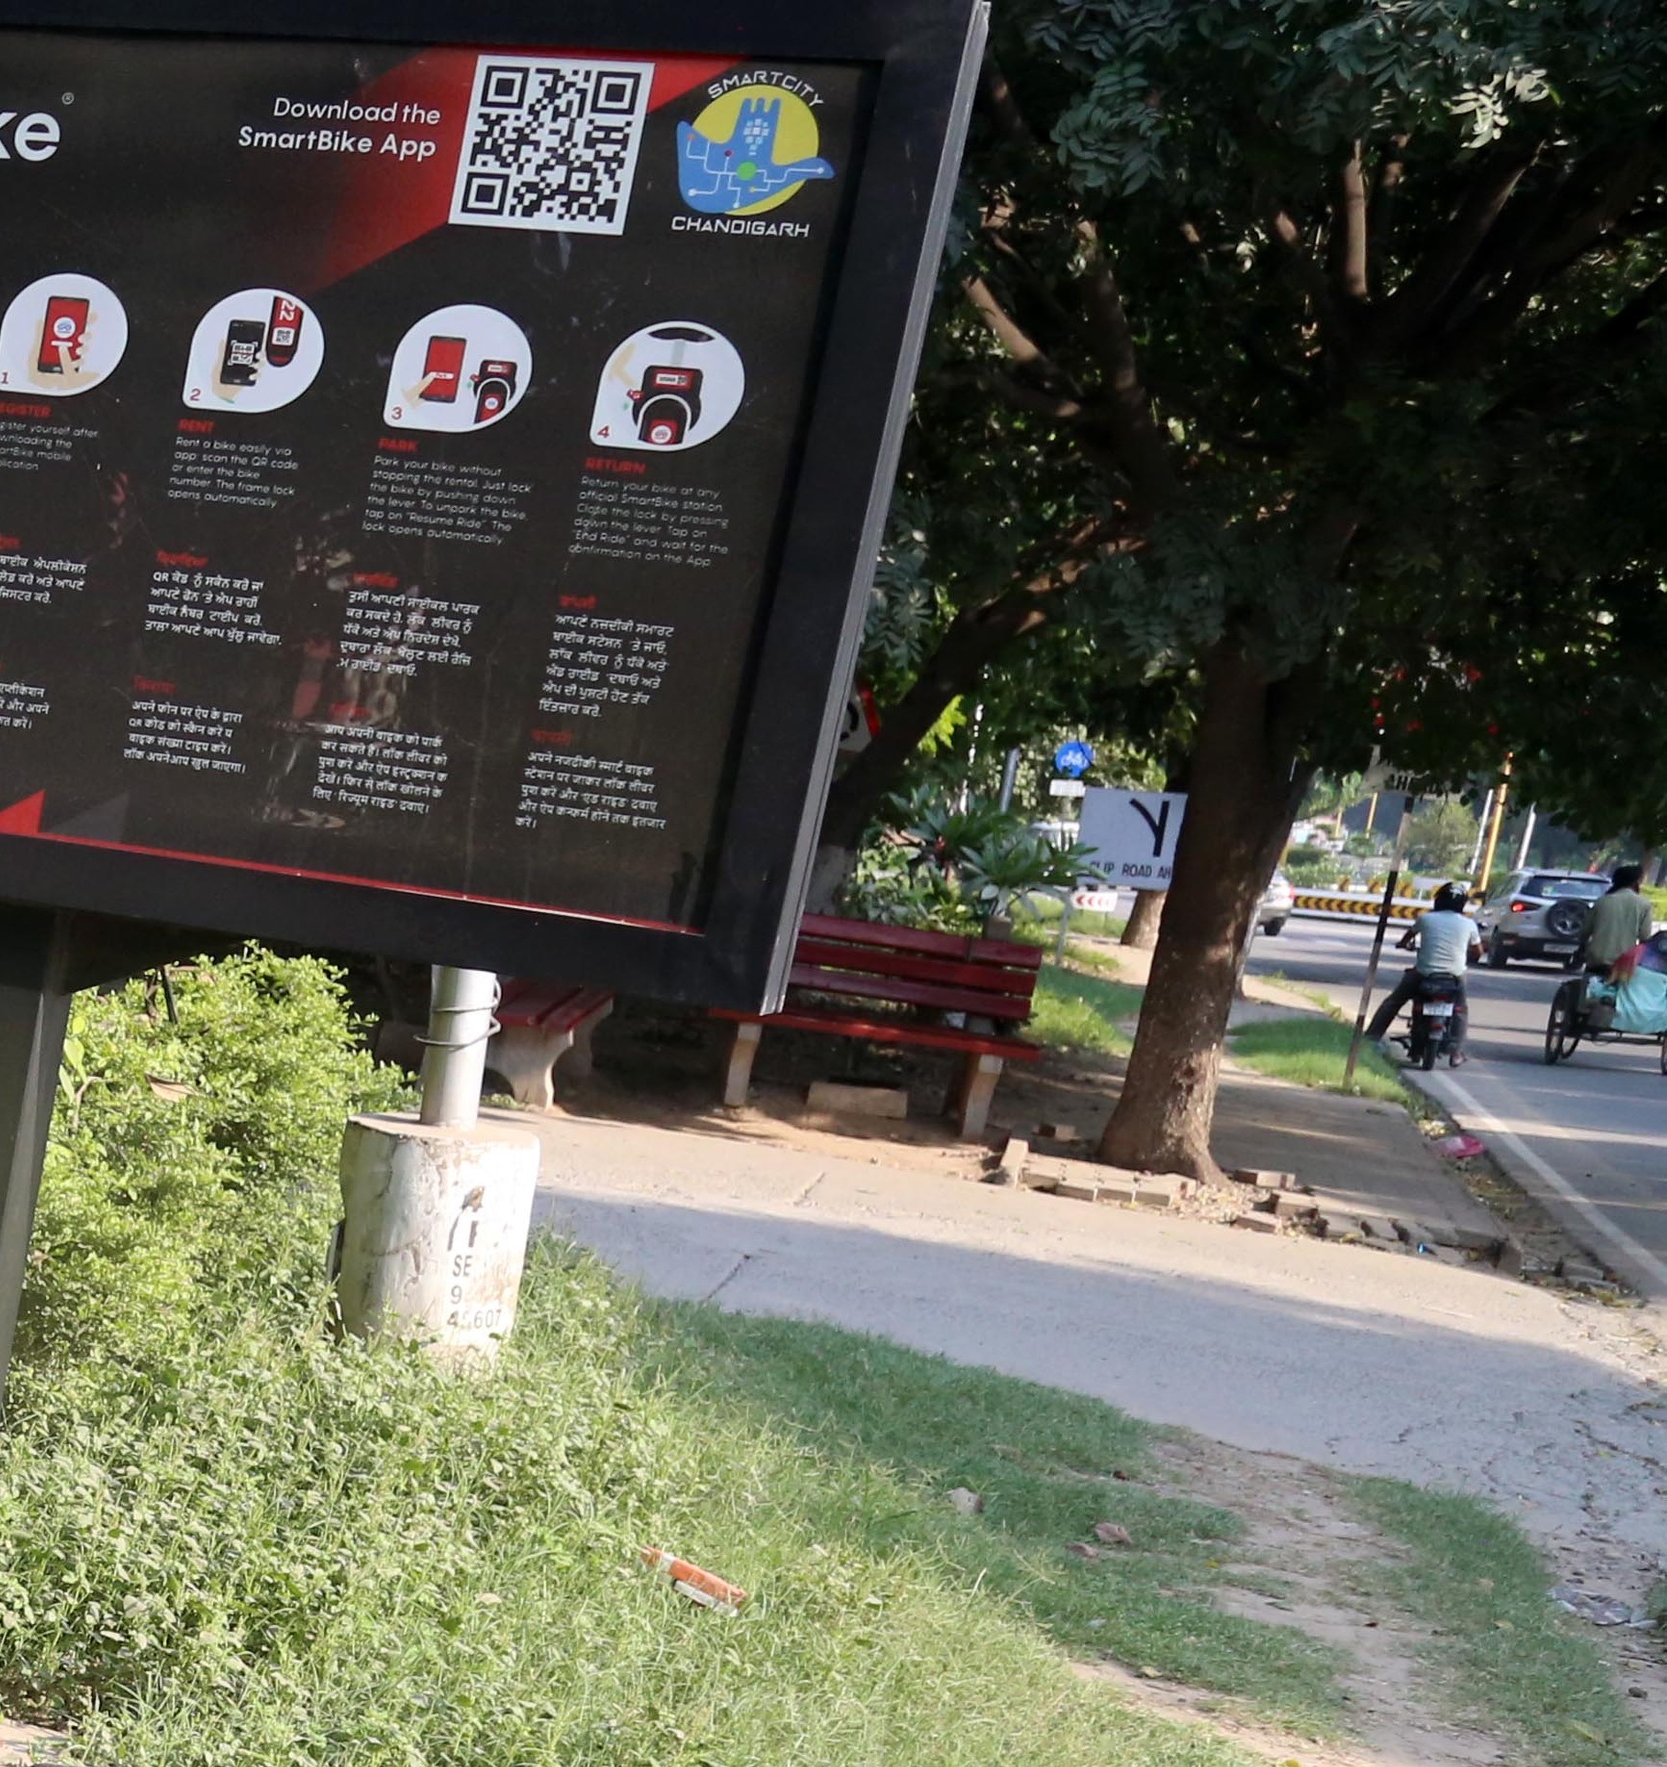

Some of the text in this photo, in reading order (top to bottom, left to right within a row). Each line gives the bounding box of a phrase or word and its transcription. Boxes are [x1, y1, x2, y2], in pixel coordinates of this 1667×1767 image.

[273, 97, 441, 126] Download the
[237, 125, 437, 163] SmartBike App
[669, 215, 811, 238] CHANDIGARH
[0, 371, 10, 384] 1
[189, 388, 201, 401] 2
[391, 406, 403, 421] 3
[596, 425, 611, 439] 4
[180, 706, 194, 717] पर
[1121, 862, 1153, 878] ROAD
